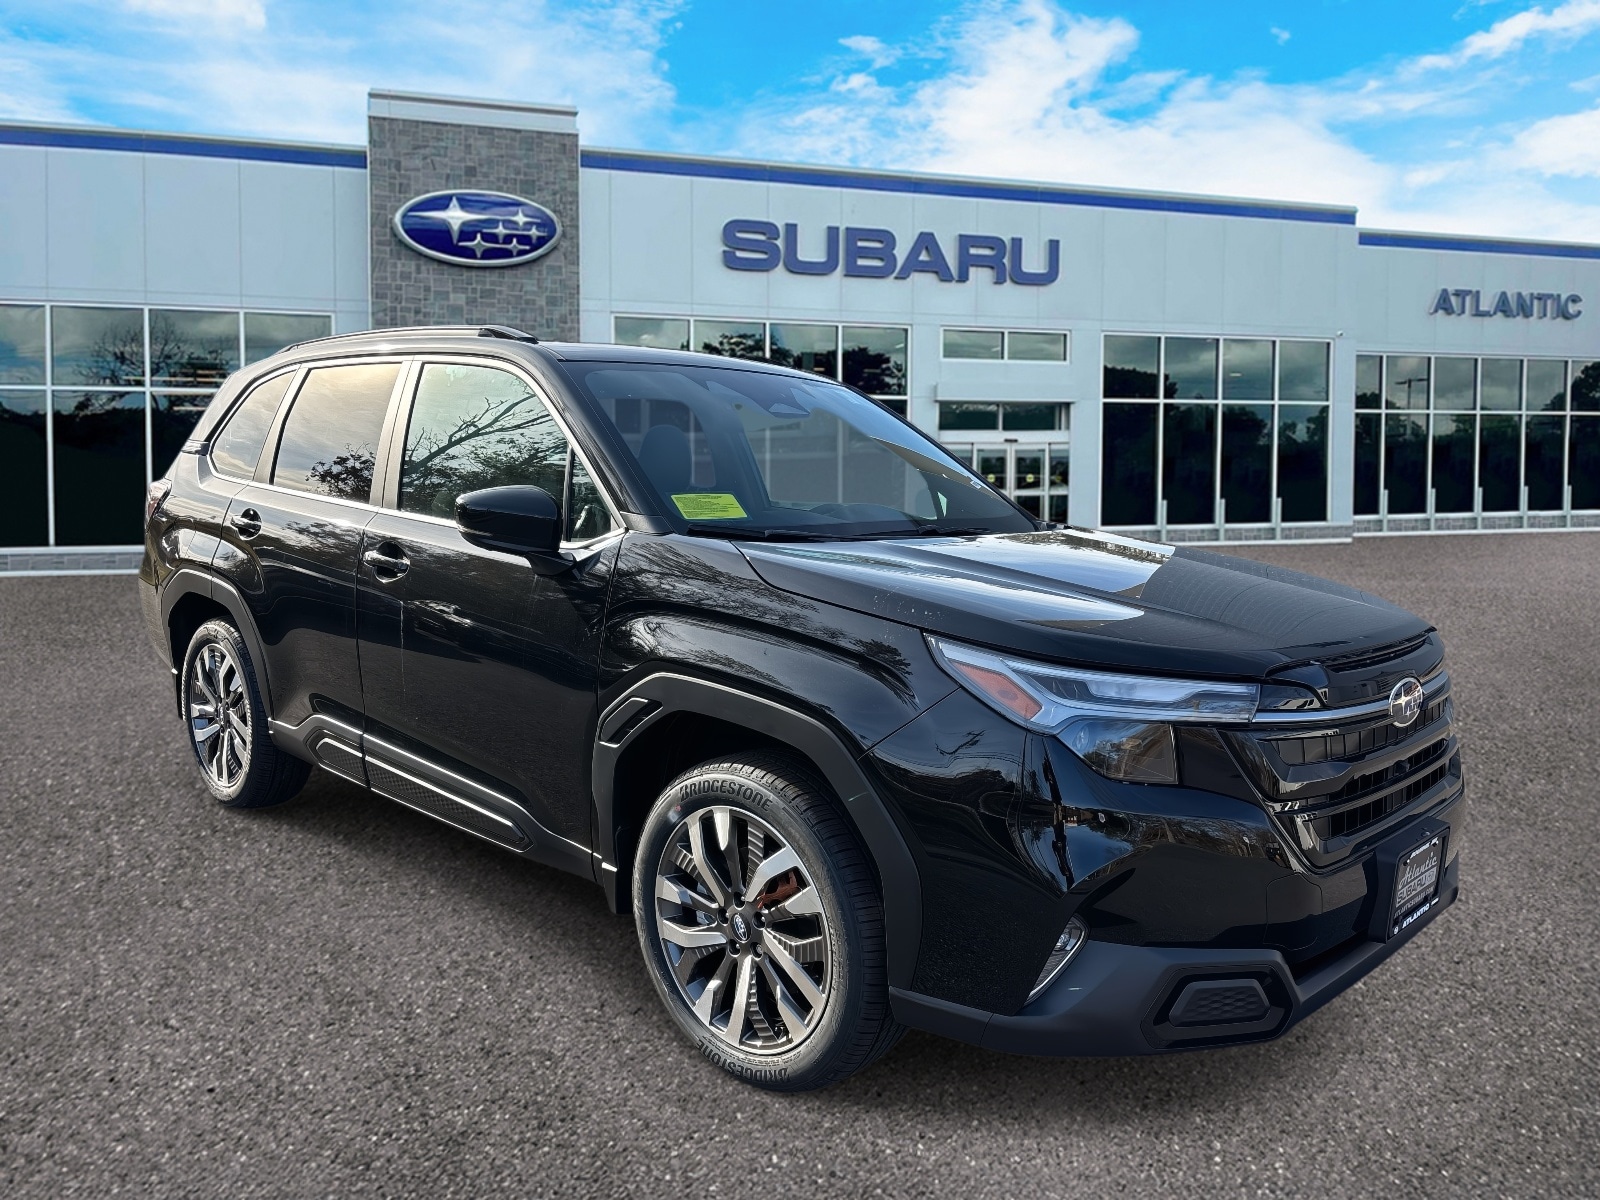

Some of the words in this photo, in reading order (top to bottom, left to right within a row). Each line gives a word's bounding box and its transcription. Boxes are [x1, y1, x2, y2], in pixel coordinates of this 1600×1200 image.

[722, 219, 1060, 286] SUBARU
[1429, 288, 1583, 320] ATLANTIC
[679, 779, 773, 812] BRIDGESTONE
[1398, 851, 1438, 890] Atlantic
[1402, 902, 1430, 929] ATLANTIC
